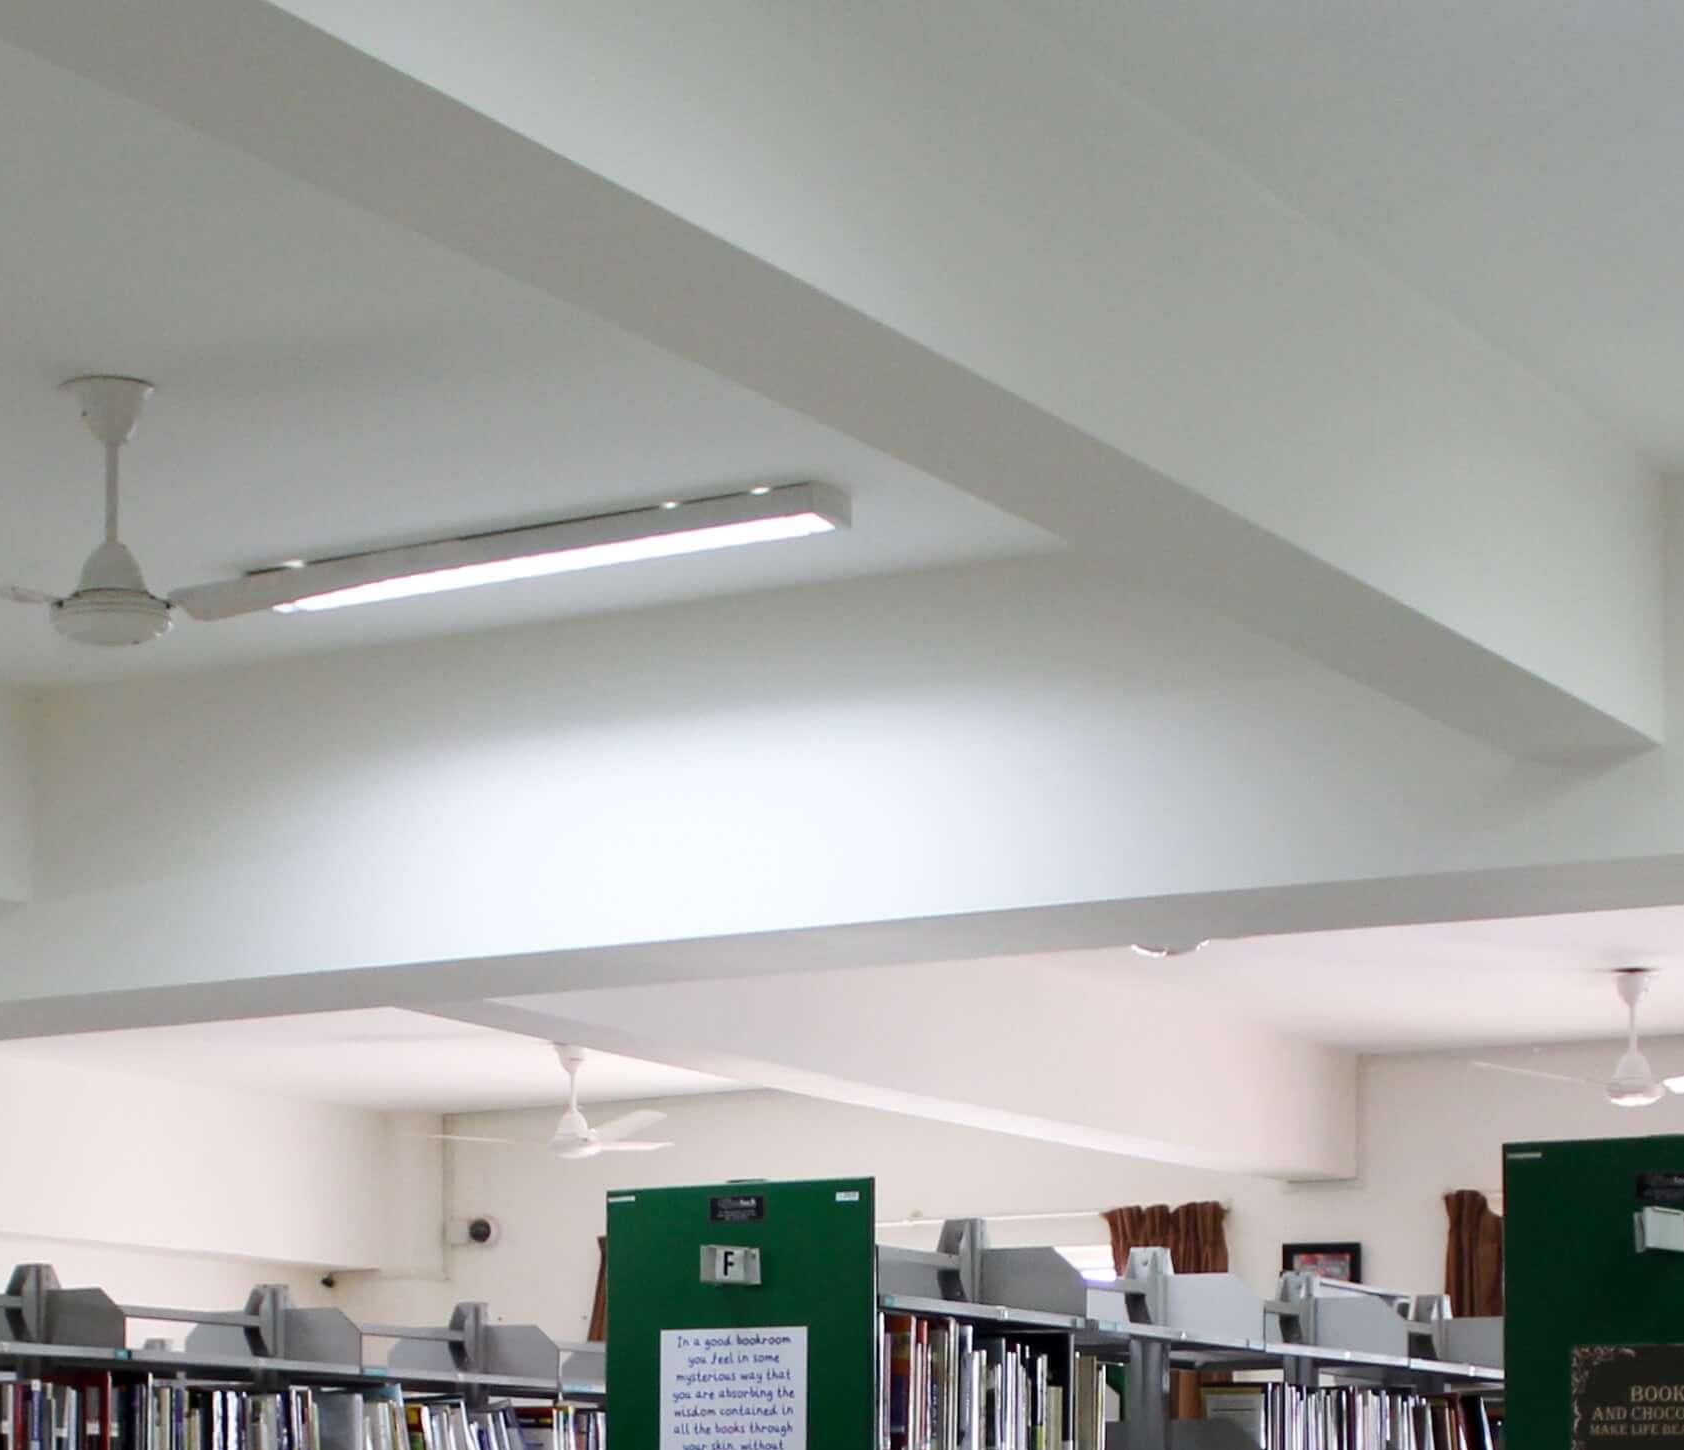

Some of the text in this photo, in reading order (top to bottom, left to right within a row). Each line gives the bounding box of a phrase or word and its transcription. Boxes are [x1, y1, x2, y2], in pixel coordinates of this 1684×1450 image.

[723, 1252, 734, 1276] F
[677, 1336, 689, 1348] In
[705, 1336, 731, 1350] good
[737, 1334, 791, 1346] bookroom
[688, 1353, 779, 1368] you feel in some
[676, 1369, 791, 1385] mysterious way that
[672, 1387, 794, 1403] you are absorbing the
[674, 1405, 793, 1417] wisdom contained in
[1592, 1406, 1627, 1421] AND
[674, 1422, 793, 1437] all the books through
[1589, 1424, 1627, 1436] MAKE
[1631, 1424, 1658, 1435] LIFE
[741, 1440, 783, 1450] without
